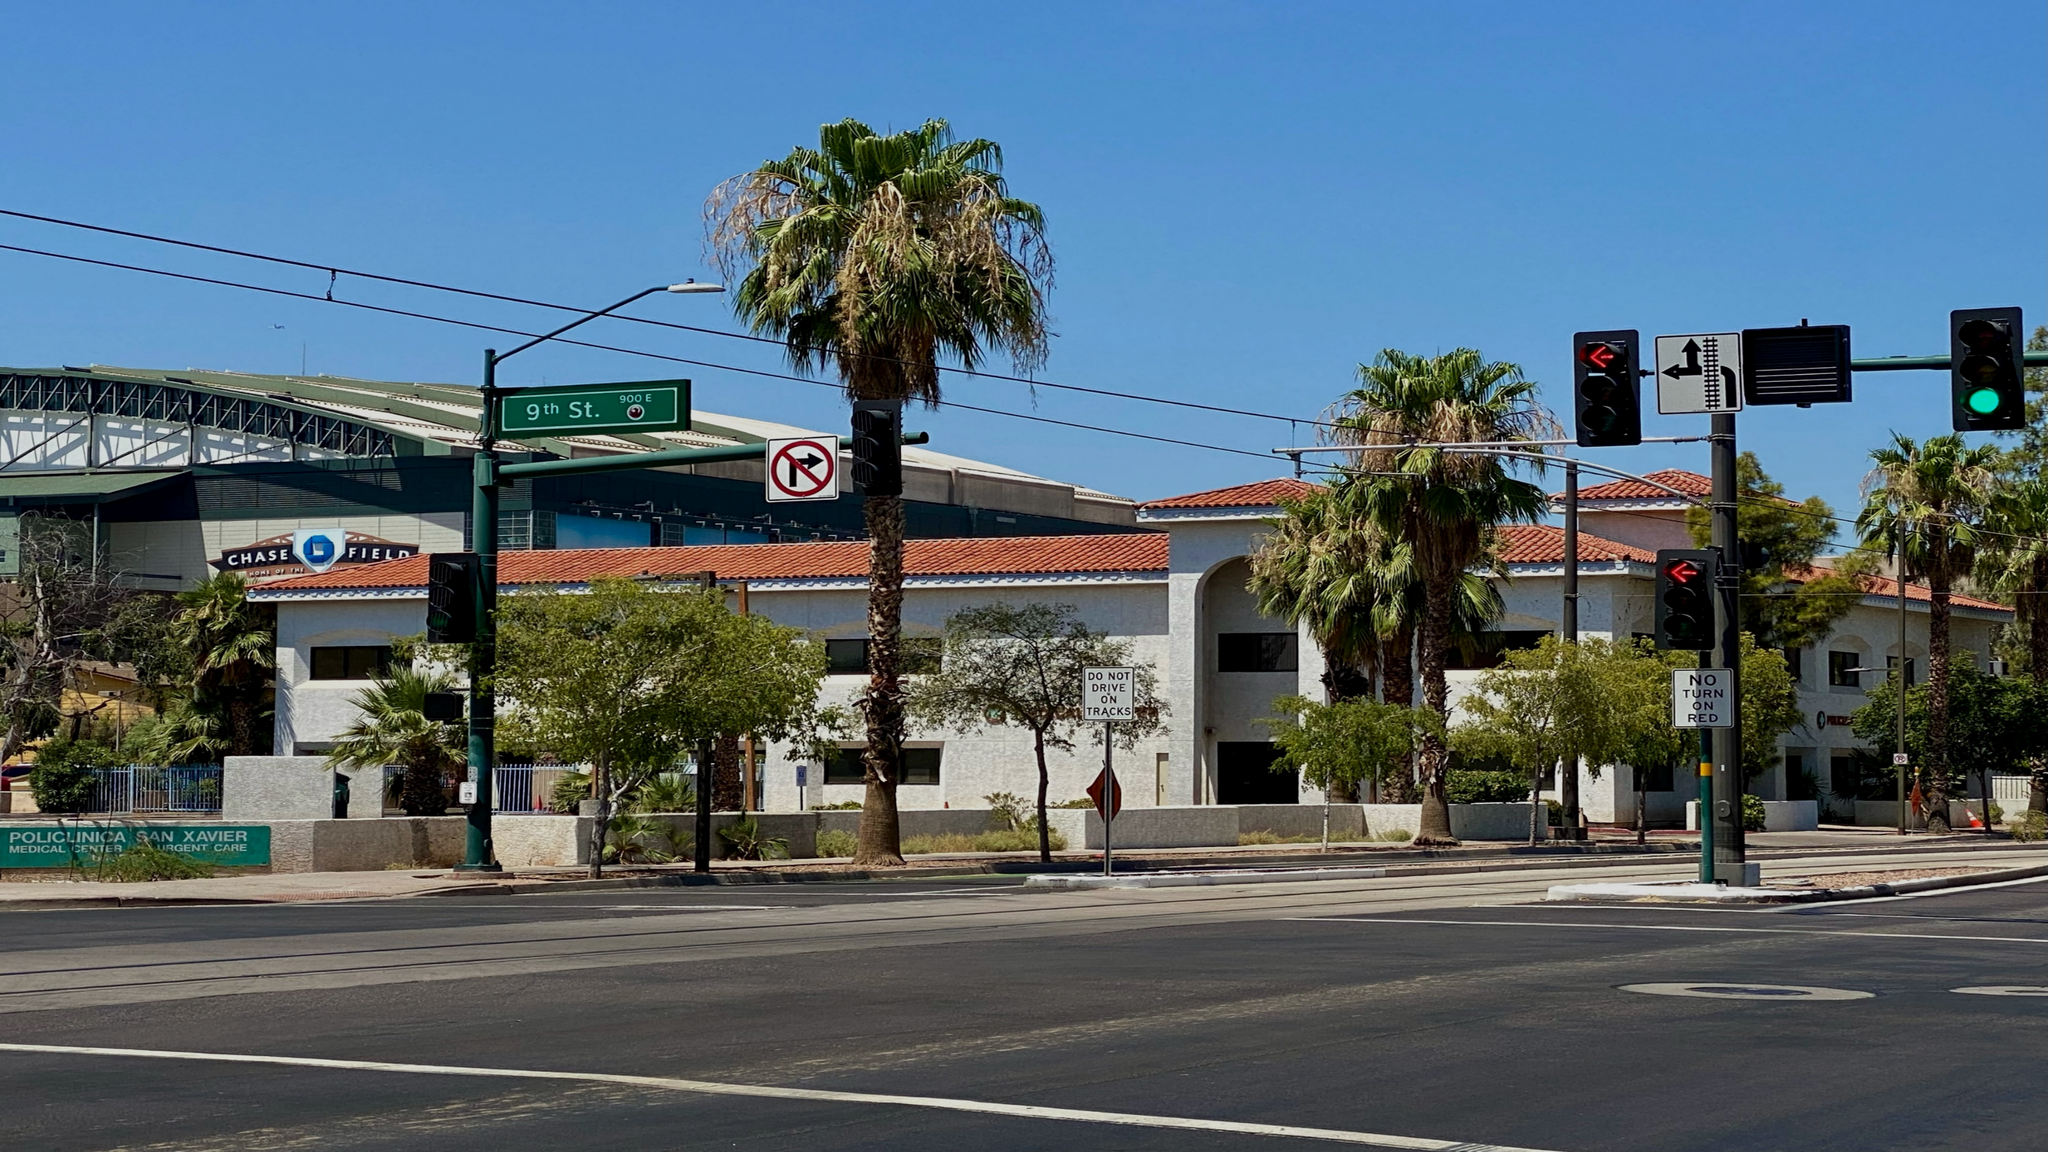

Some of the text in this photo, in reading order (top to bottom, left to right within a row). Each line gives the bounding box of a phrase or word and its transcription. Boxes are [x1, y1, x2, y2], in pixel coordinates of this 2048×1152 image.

[619, 393, 652, 404] 900 E
[526, 401, 600, 421] 9th St.
[227, 547, 411, 566] CHASE FIELD
[1088, 672, 1130, 680] DO NOT
[1689, 674, 1717, 686] NO
[1092, 683, 1126, 692] DRIVE
[1682, 689, 1724, 698] TURN
[1100, 695, 1117, 704] ON
[1692, 701, 1714, 710] ON
[1087, 707, 1131, 716] TRACKS
[1688, 713, 1719, 723] RED
[9, 830, 247, 844] POLICLINICA SAN XAVIER
[9, 843, 248, 854] MEDICAL CENTER URGENT CARE
